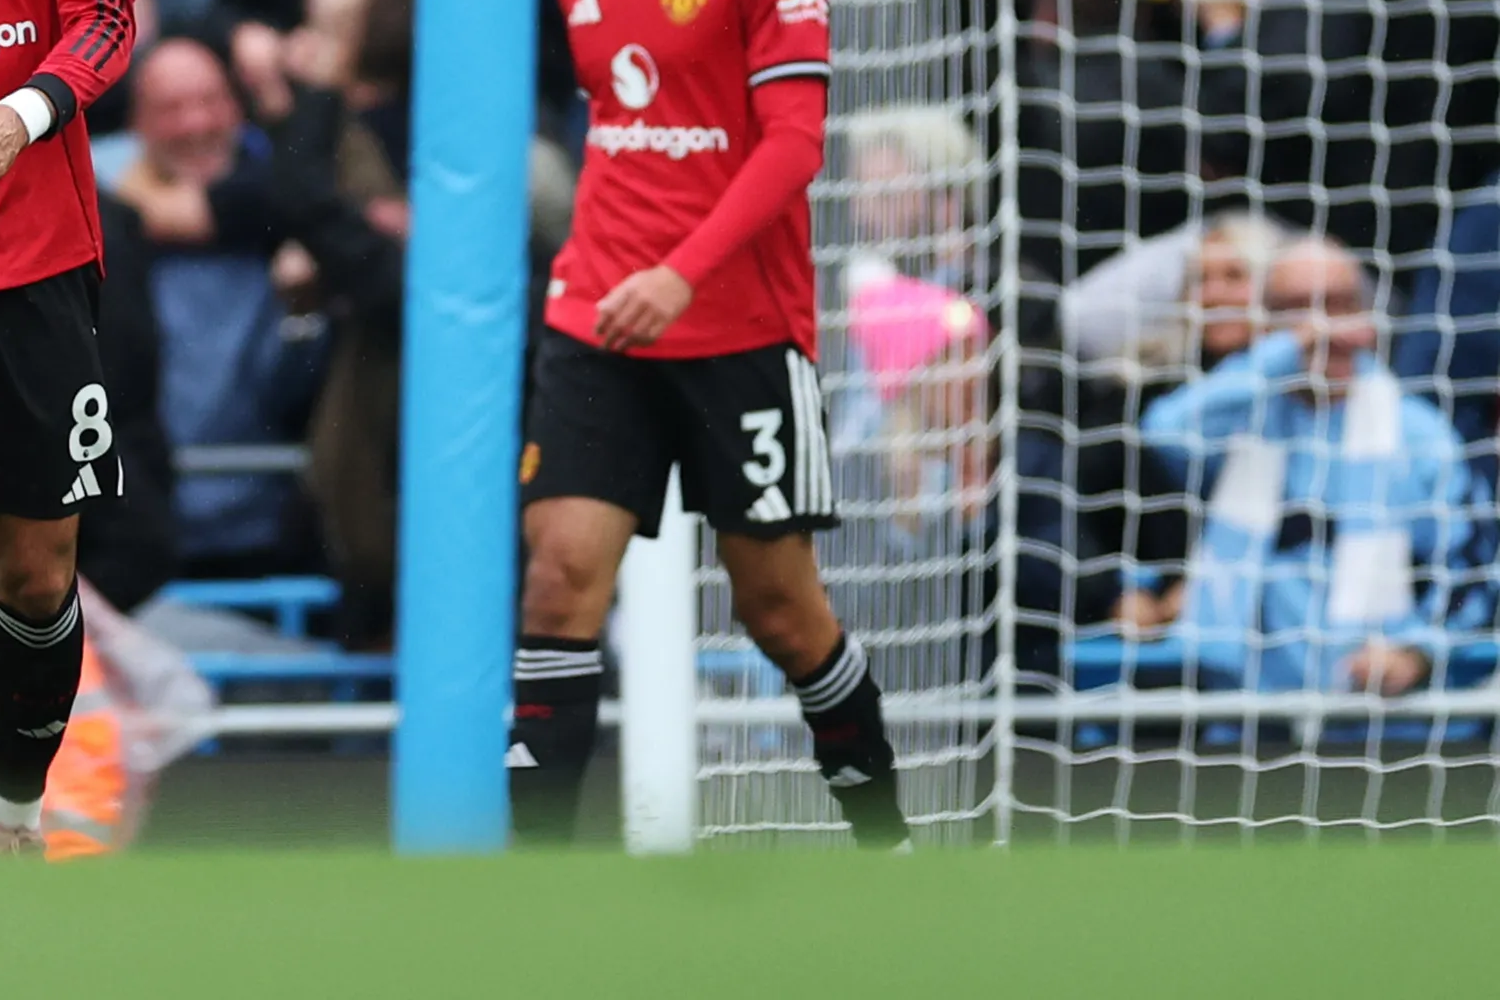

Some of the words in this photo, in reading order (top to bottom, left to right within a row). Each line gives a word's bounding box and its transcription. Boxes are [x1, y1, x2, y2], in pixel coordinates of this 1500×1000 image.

[586, 118, 729, 160] apdragon
[69, 383, 113, 462] 8
[741, 408, 786, 486] 3
